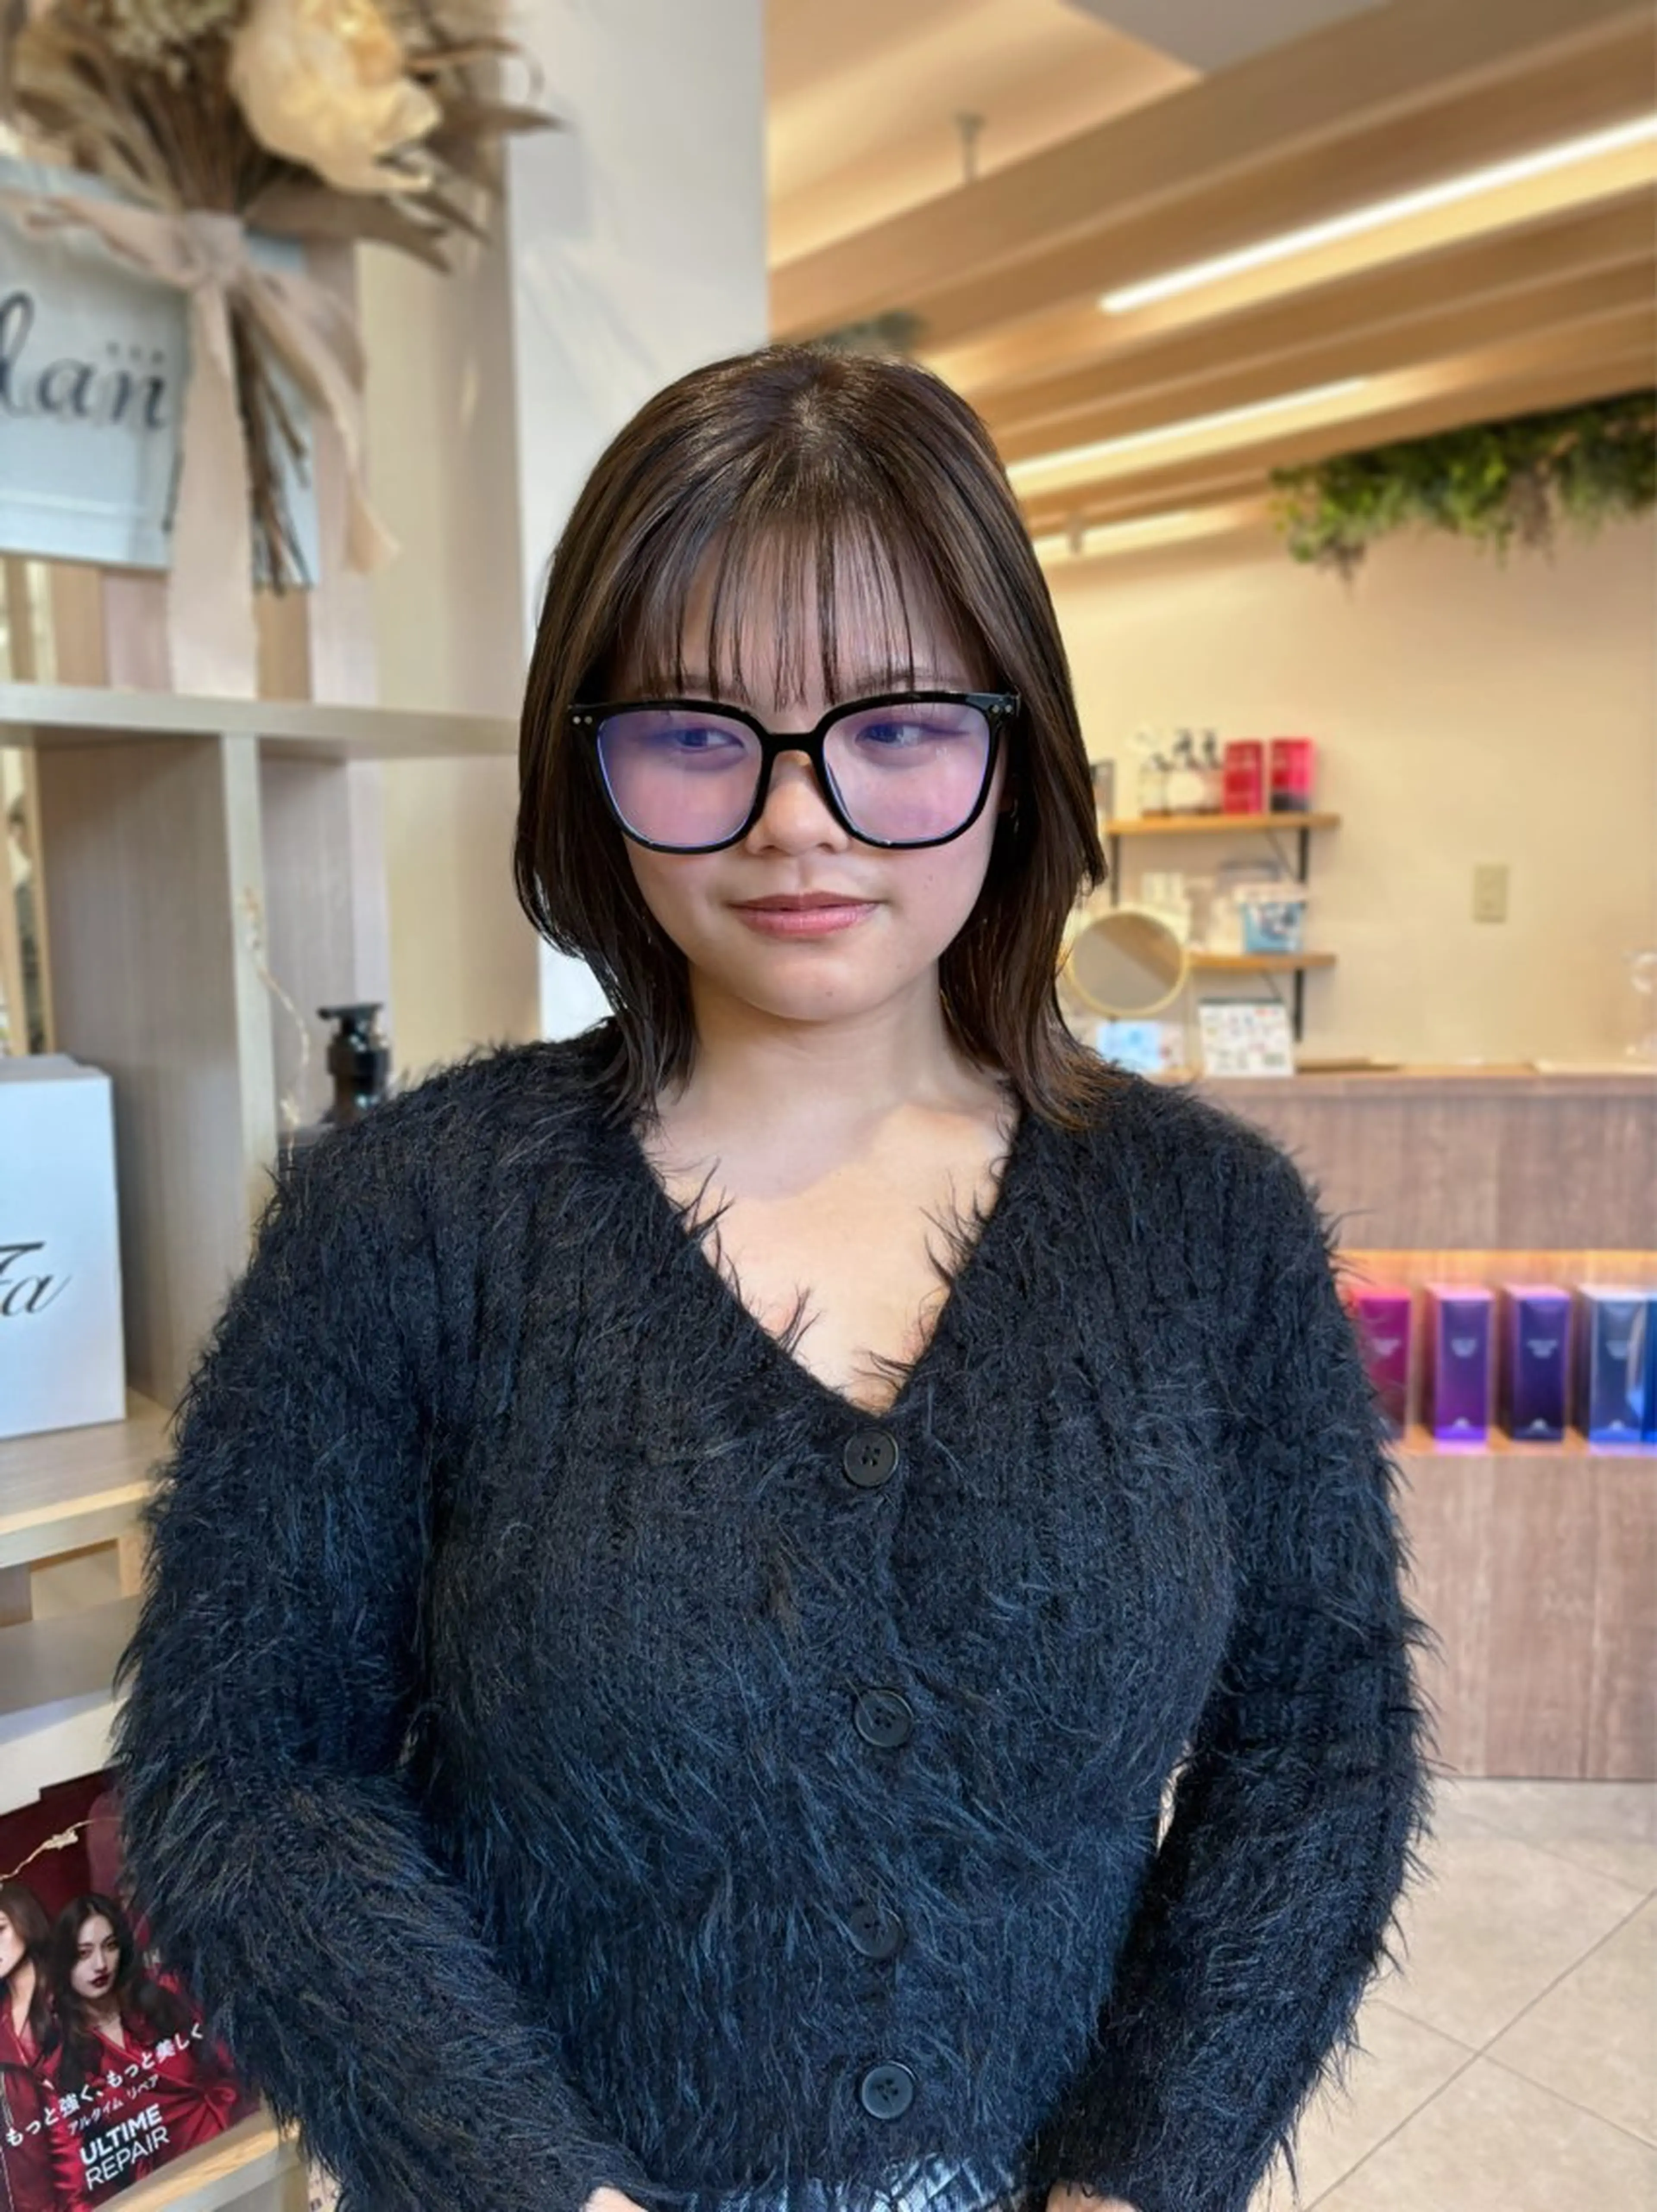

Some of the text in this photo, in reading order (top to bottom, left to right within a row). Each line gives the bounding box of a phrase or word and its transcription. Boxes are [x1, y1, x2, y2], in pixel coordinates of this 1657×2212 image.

[6, 2023, 203, 2146] もっと強く、もっと美しく
[79, 2103, 163, 2165] ULTIME
[85, 2126, 170, 2191] REPAIR
